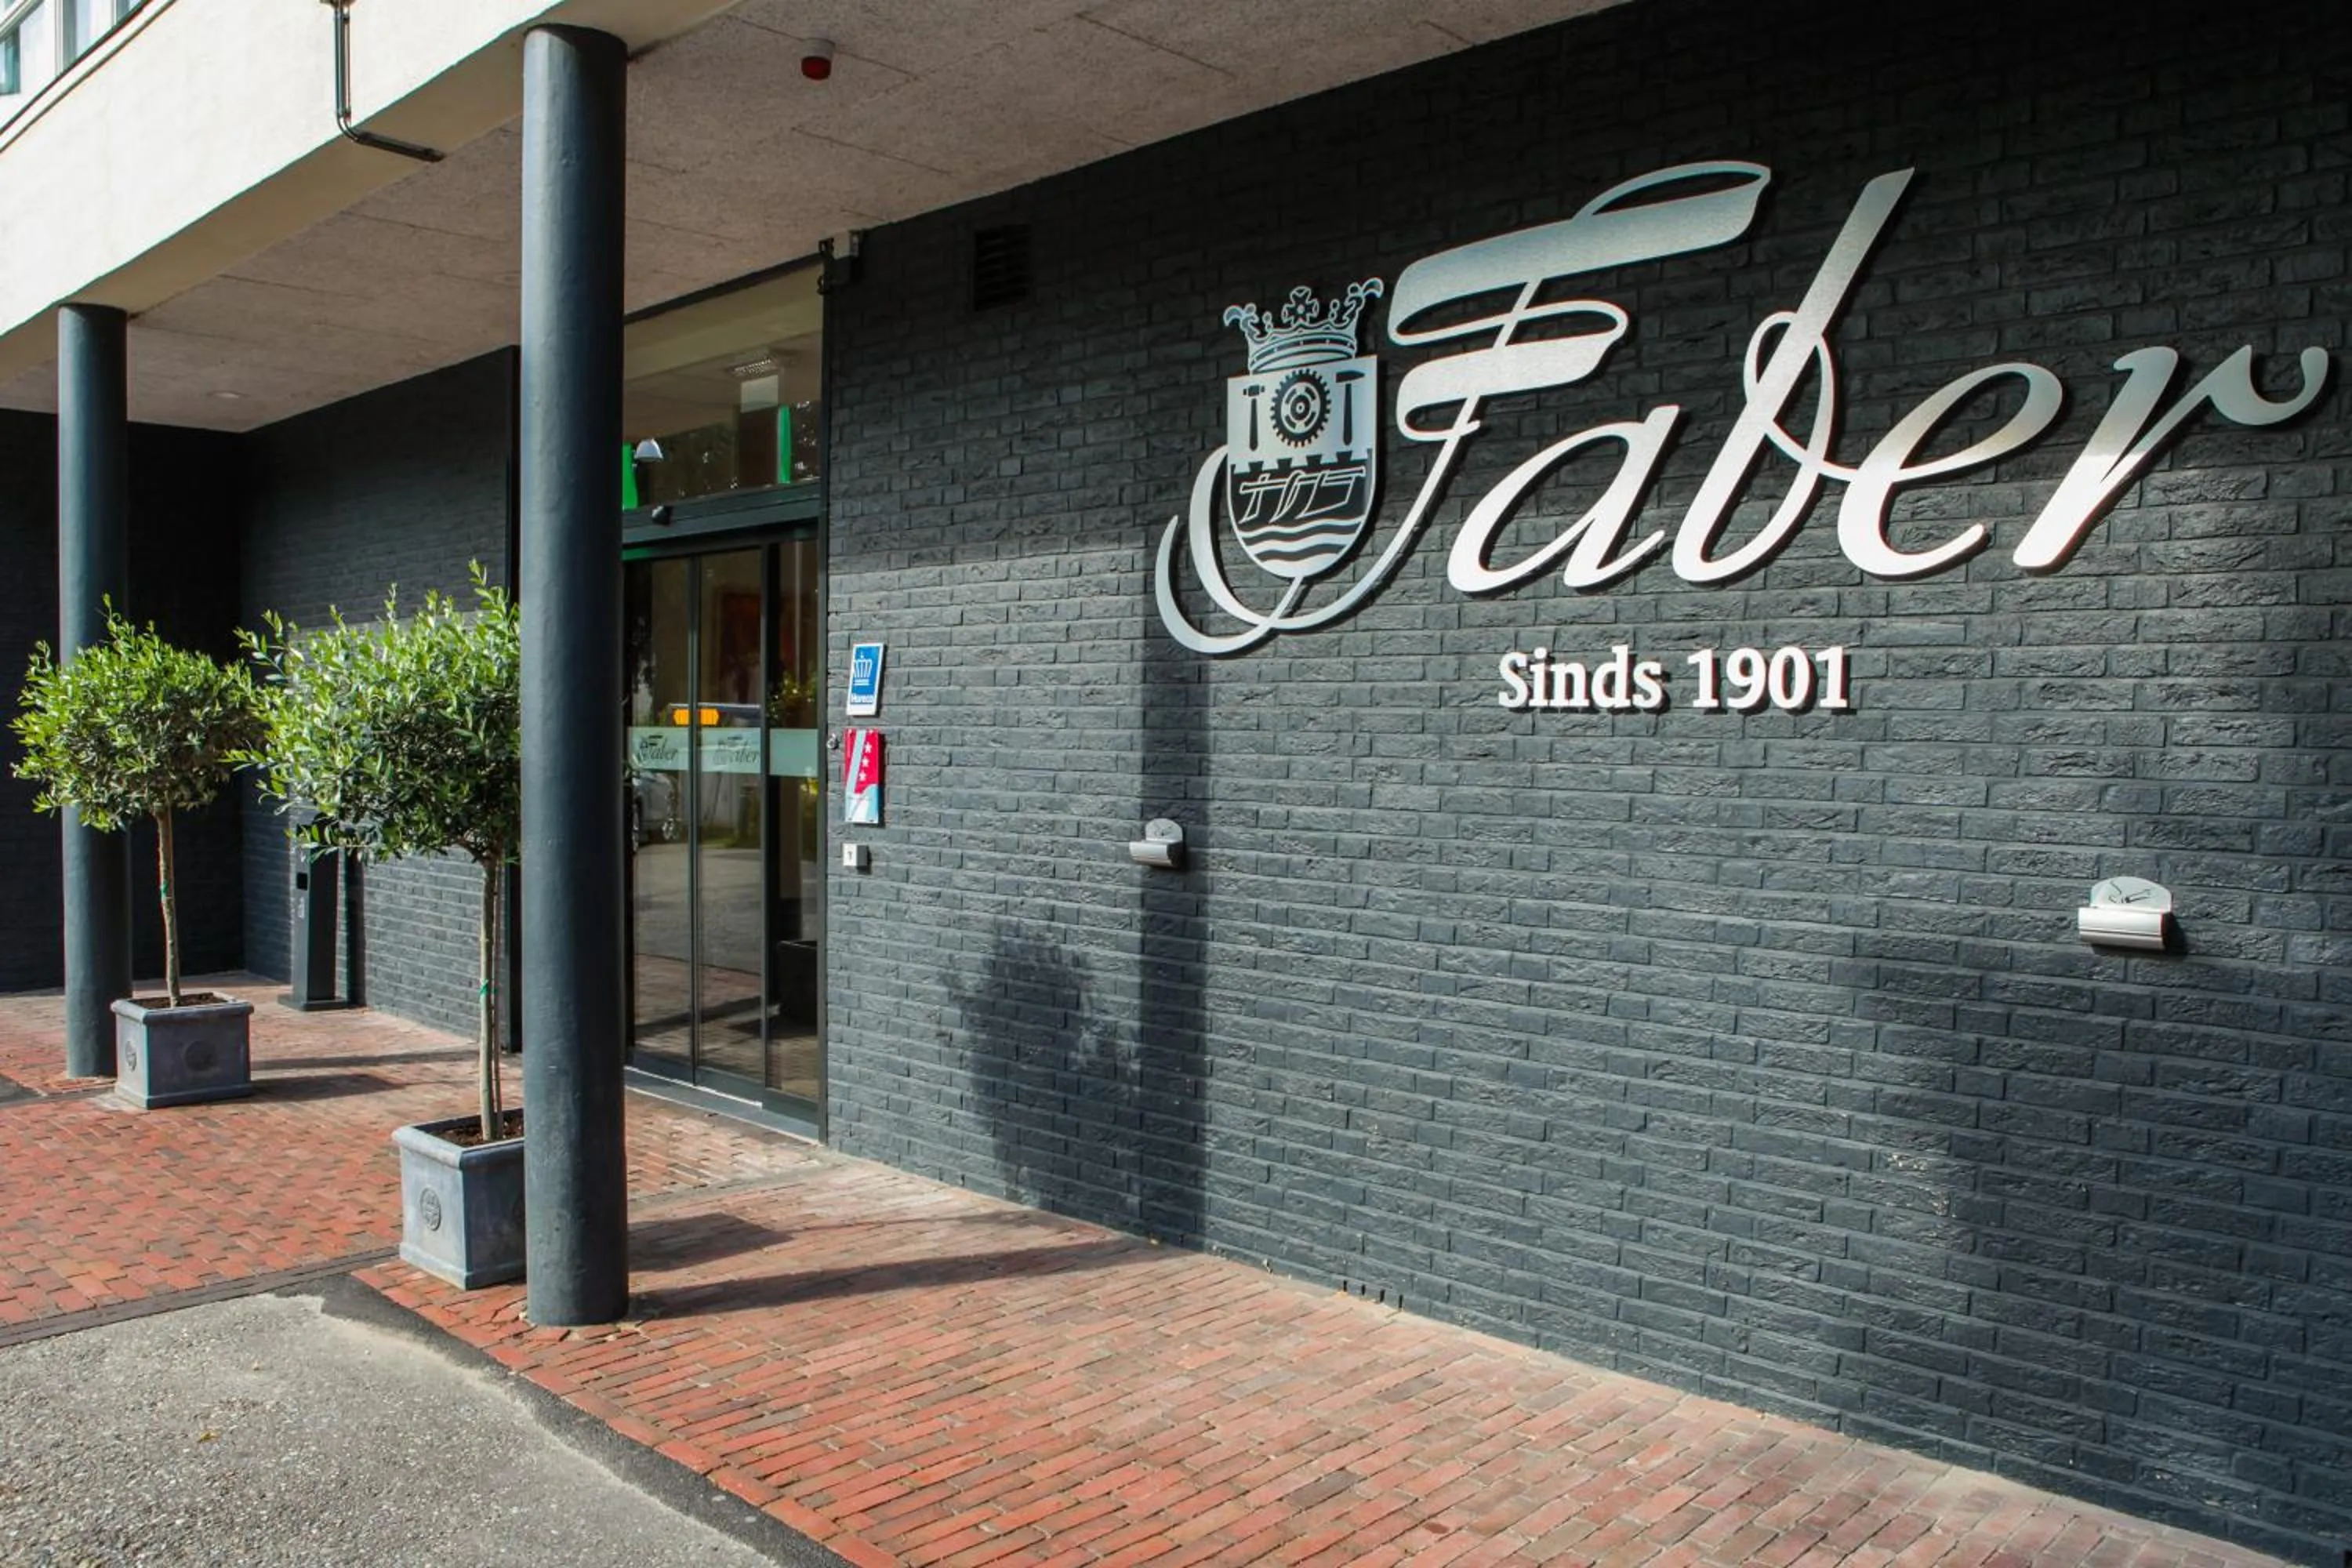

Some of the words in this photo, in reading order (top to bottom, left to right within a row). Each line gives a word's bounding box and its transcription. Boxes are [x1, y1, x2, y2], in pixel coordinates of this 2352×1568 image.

[1156, 160, 2328, 654] Faber
[1497, 644, 1663, 708] Sinds
[1686, 644, 1849, 709] 1901
